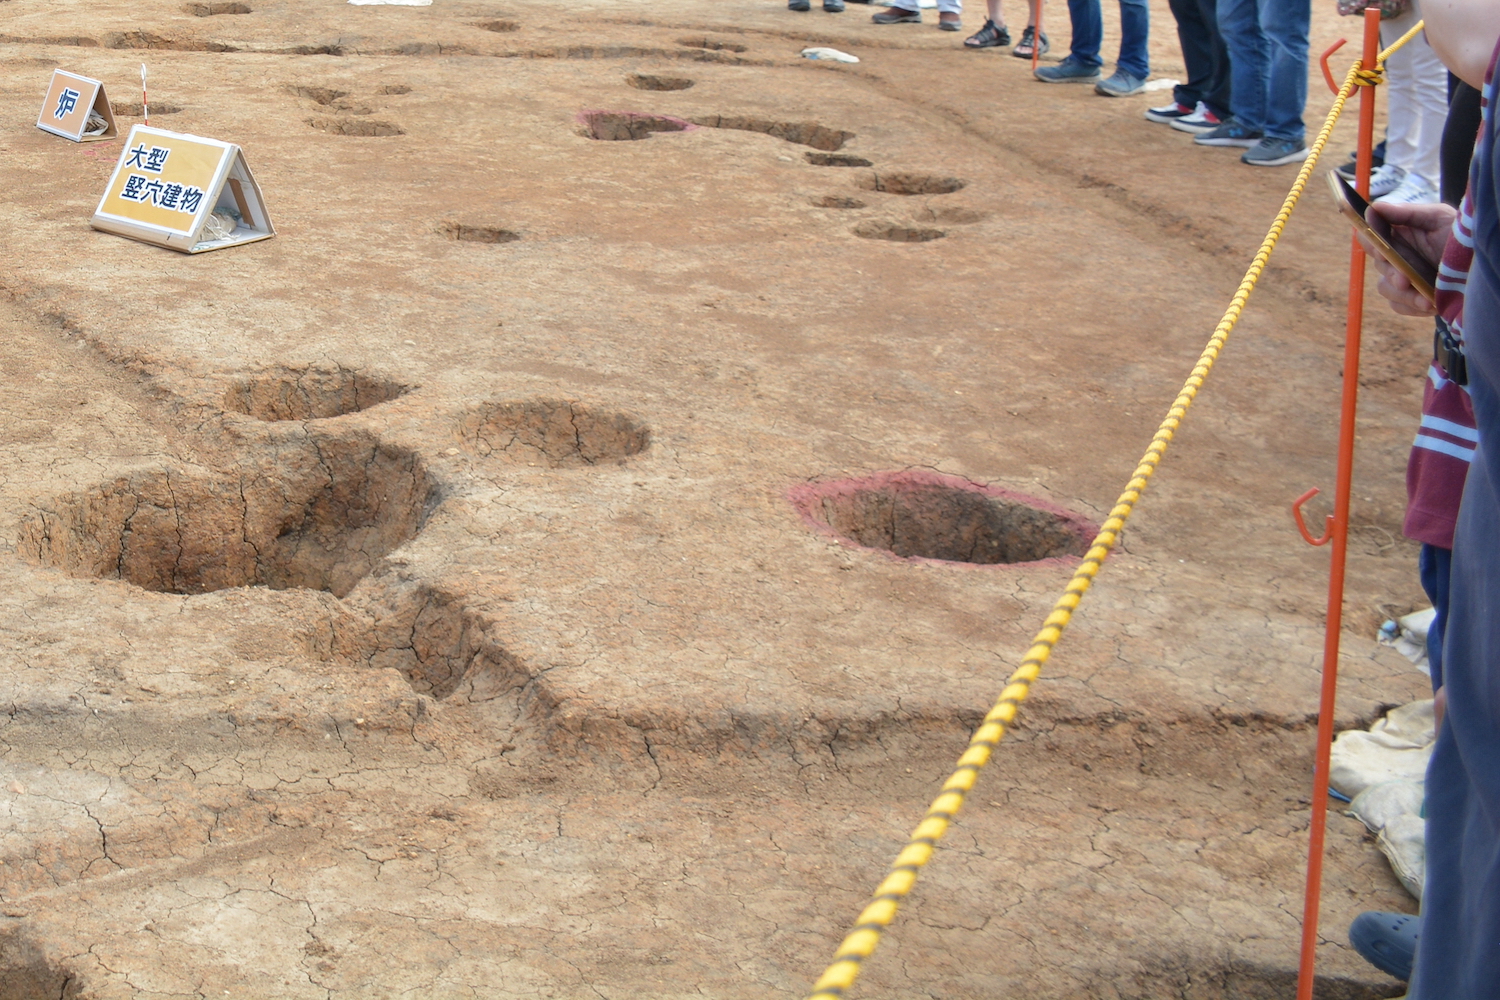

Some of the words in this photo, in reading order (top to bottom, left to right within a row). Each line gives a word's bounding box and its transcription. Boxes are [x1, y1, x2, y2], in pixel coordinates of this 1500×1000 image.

[55, 88, 79, 118] 炉
[126, 144, 169, 172] 大型
[121, 175, 203, 213] 竪穴建物
